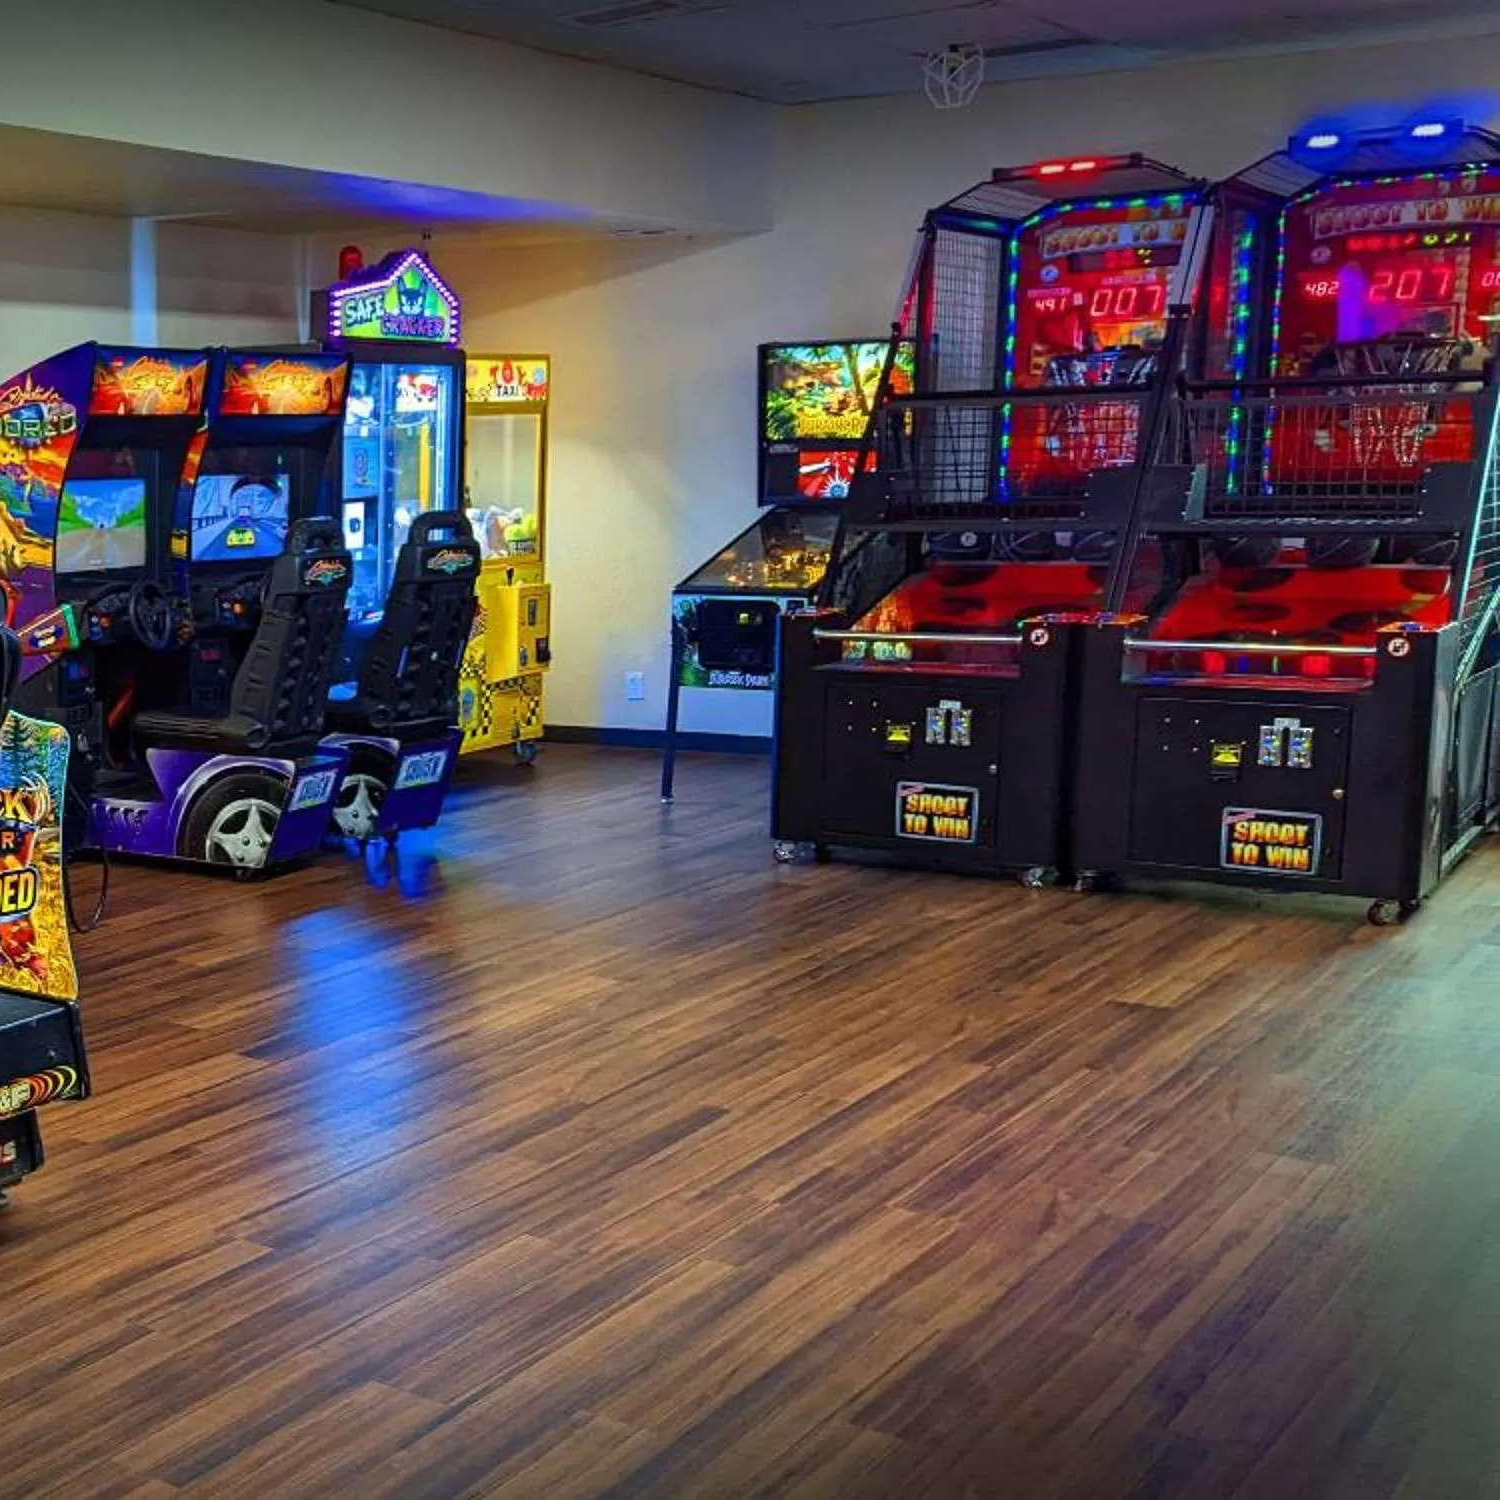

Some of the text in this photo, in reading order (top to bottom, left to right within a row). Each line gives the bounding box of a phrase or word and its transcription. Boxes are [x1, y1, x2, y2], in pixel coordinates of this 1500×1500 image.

[1304, 281, 1340, 297] 482
[1368, 267, 1453, 304] 207
[344, 296, 384, 327] SAFE
[1035, 297, 1067, 312] 491
[1090, 285, 1162, 317] 007
[381, 315, 446, 338] CRACKER
[489, 359, 527, 386] TOY
[495, 384, 520, 398] TAXI
[905, 793, 969, 817] SHOOT
[903, 813, 970, 839] TO WIN
[1233, 821, 1309, 846] SHOOT
[1232, 844, 1310, 870] TO WIN
